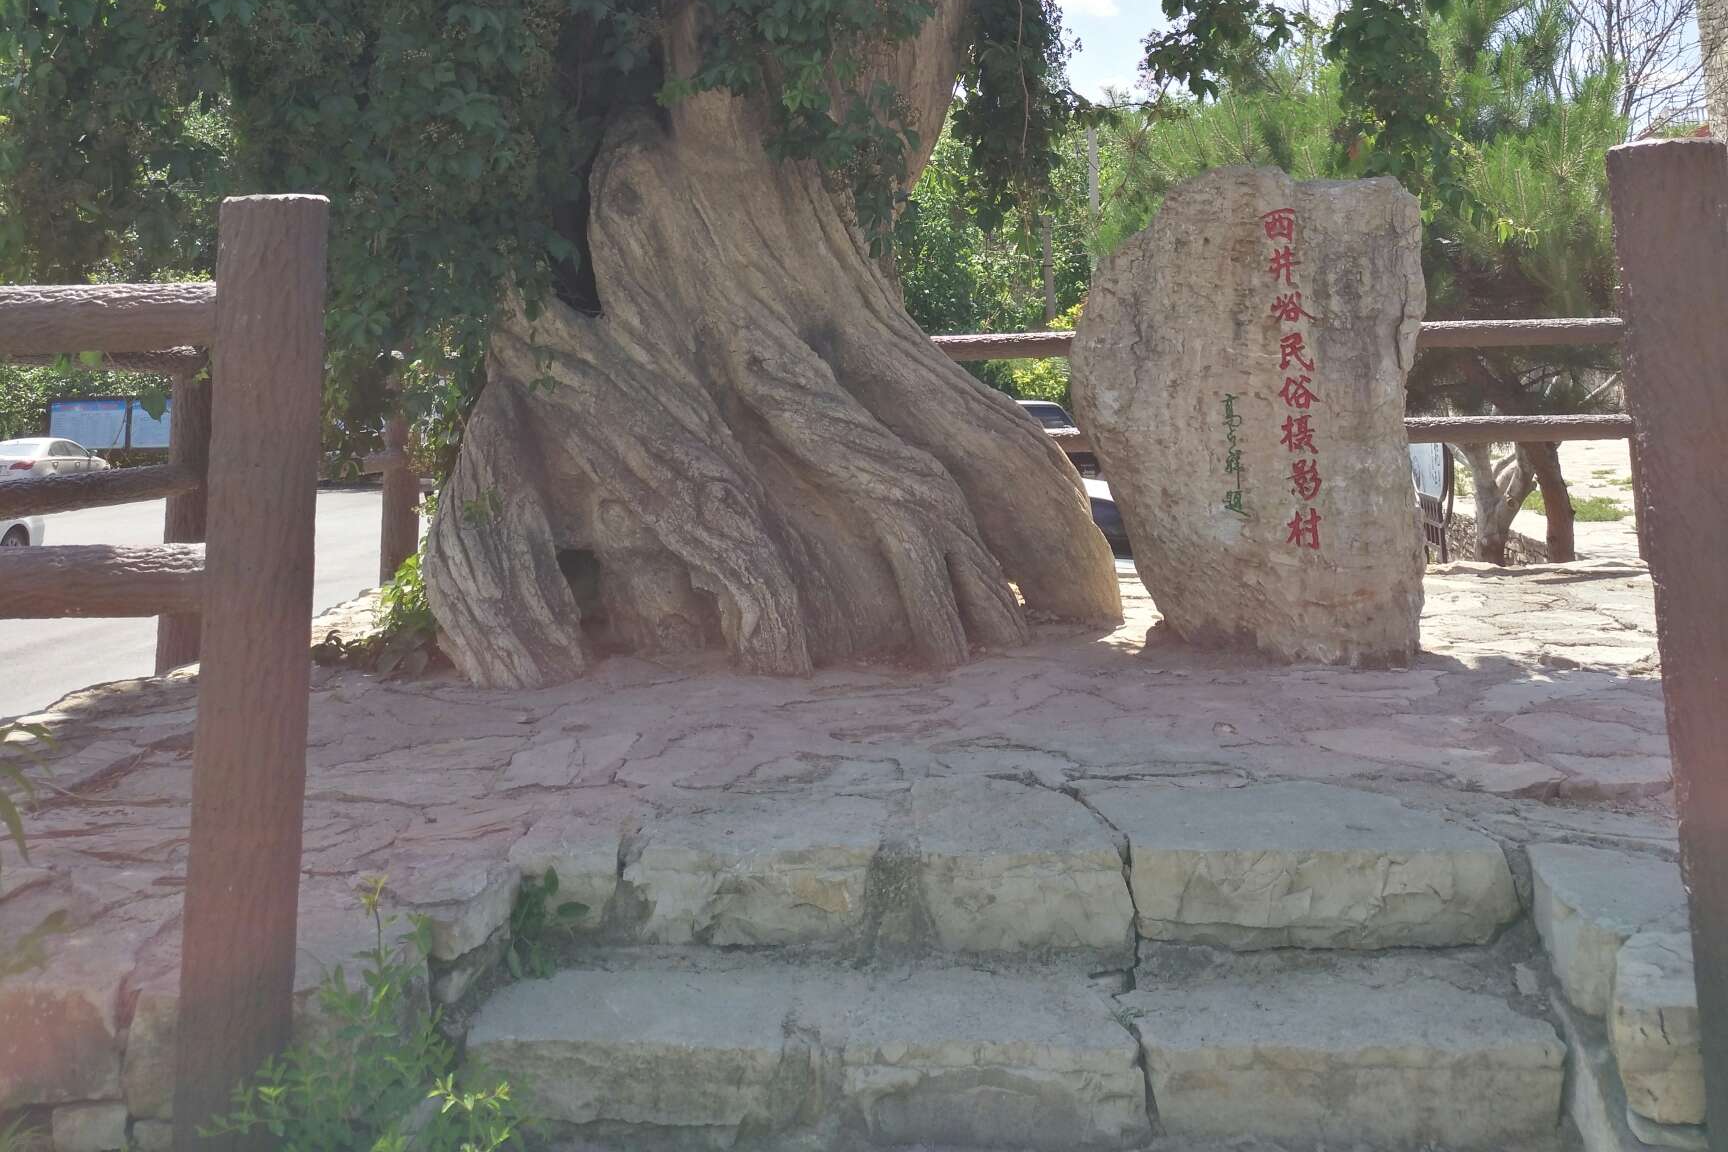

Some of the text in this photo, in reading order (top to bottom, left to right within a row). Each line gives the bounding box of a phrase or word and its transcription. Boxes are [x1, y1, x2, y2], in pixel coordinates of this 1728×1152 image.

[1260, 208, 1321, 549] 西井峪民俗摄影村
